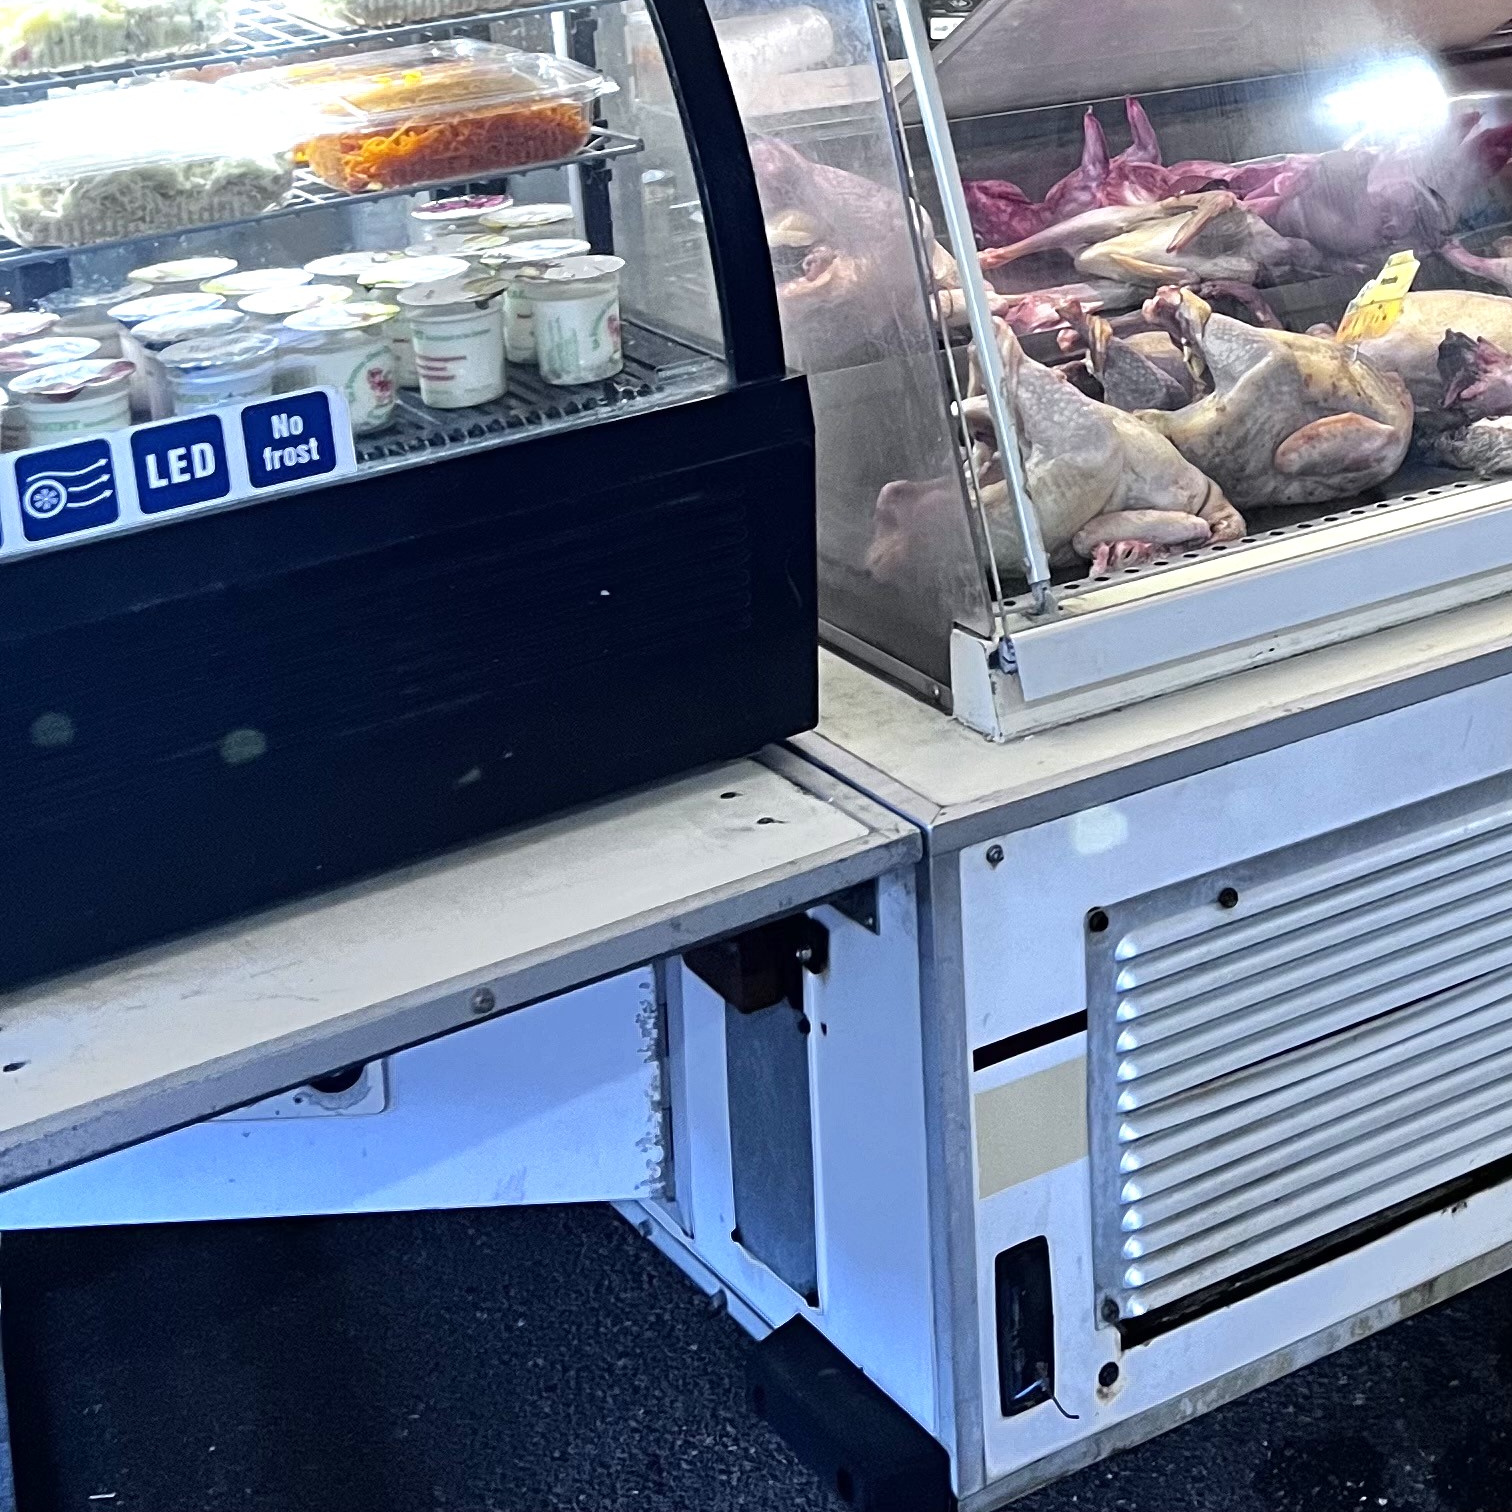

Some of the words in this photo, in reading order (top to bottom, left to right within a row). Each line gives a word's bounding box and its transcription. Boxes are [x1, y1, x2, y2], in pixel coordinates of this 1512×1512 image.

[270, 413, 304, 439] No
[146, 442, 217, 489] LED
[262, 437, 320, 471] frost
